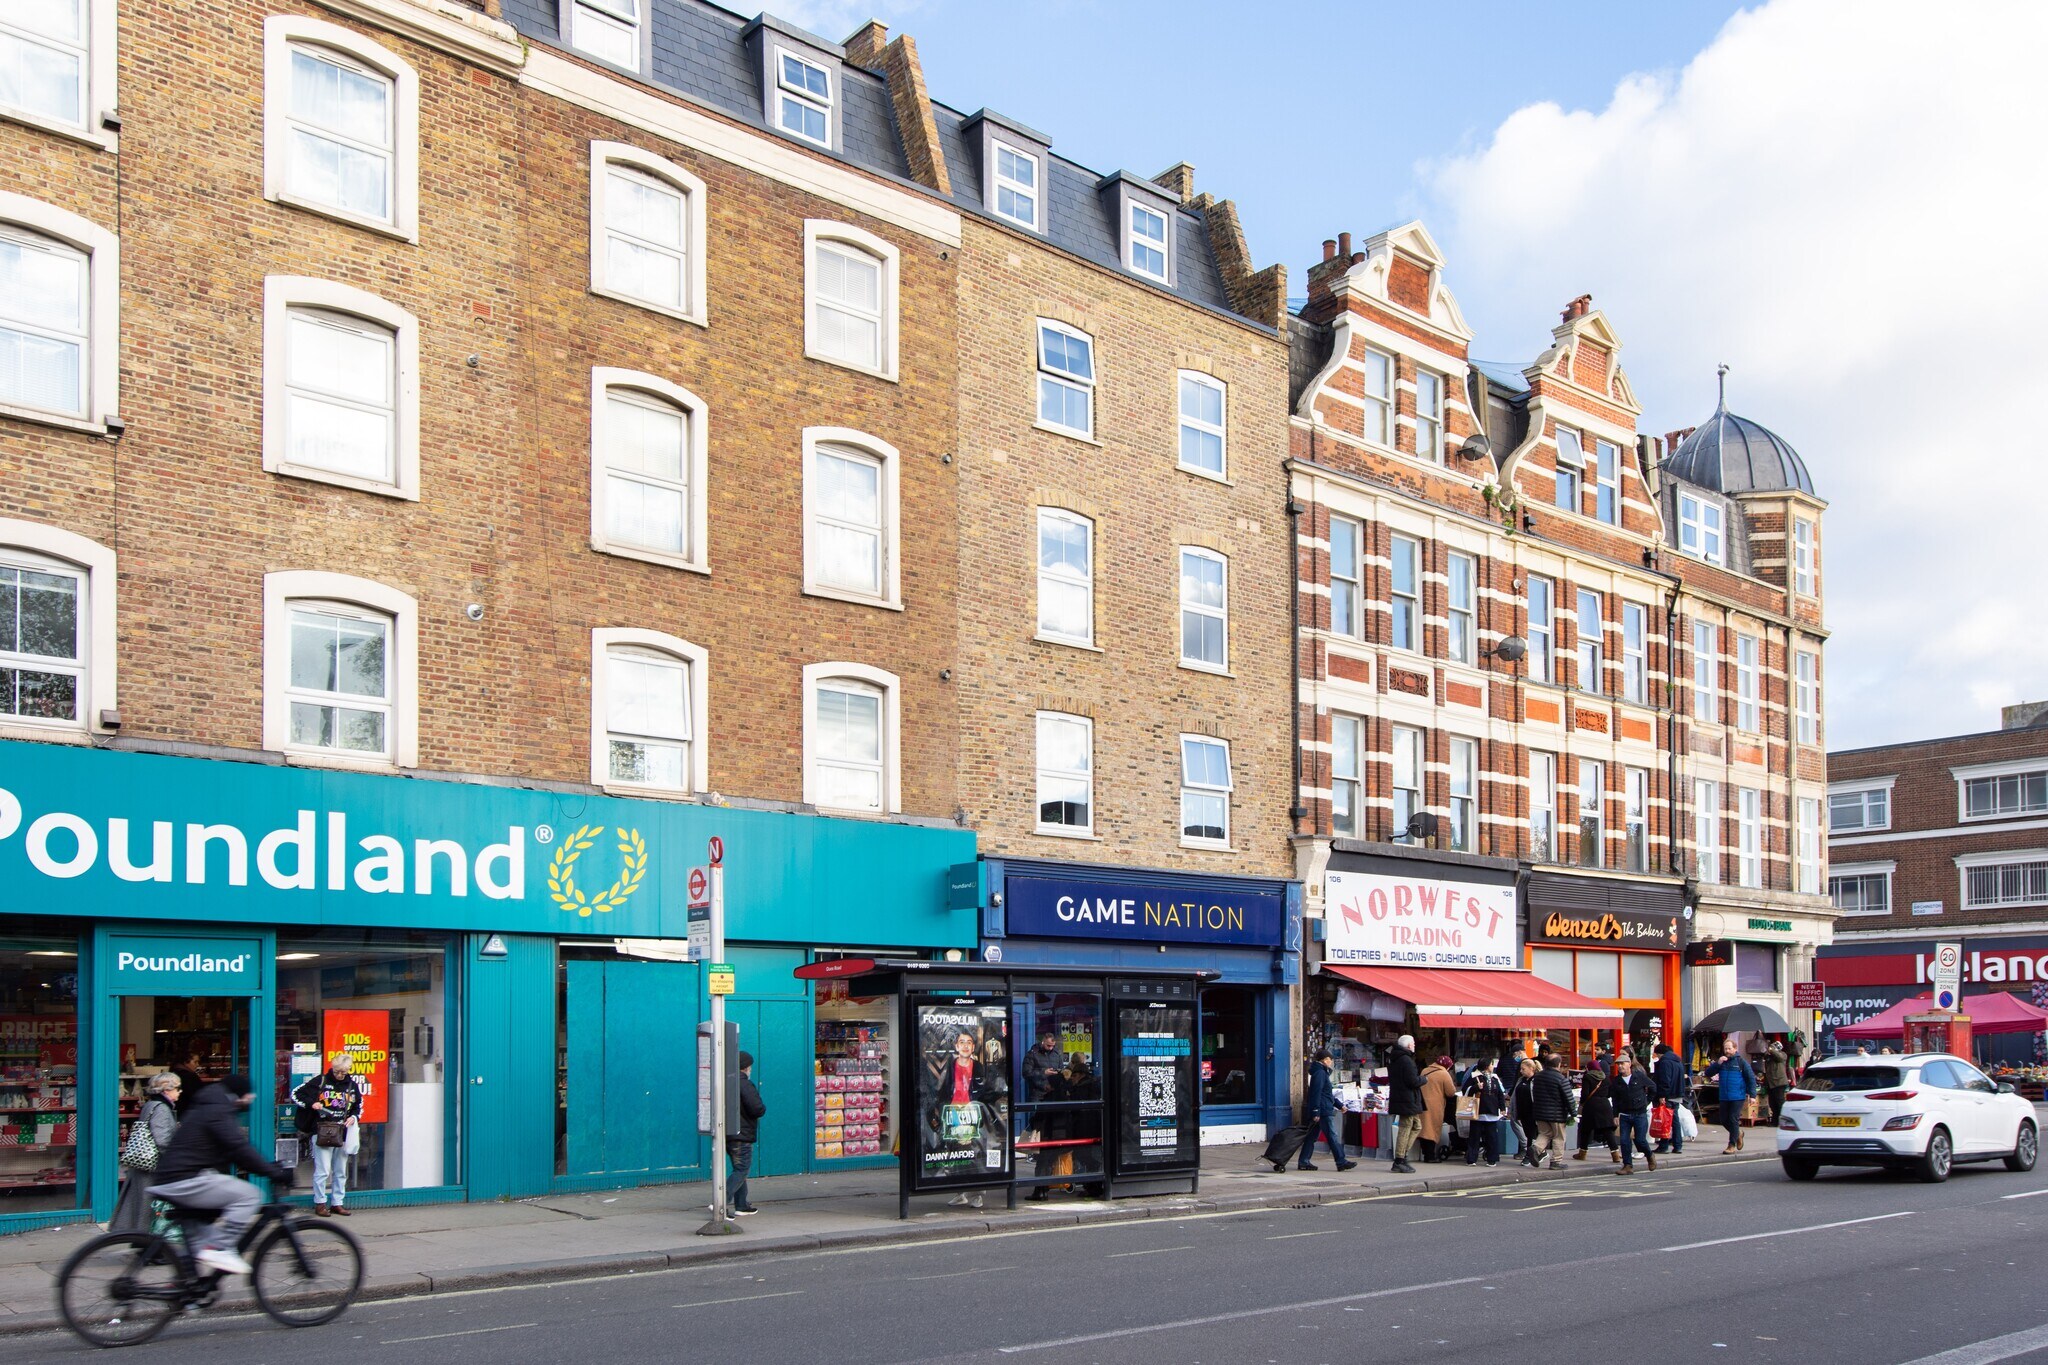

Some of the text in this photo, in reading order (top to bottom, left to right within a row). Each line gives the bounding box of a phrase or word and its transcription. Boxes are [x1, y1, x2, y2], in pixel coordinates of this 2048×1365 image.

[710, 840, 719, 860] N
[1056, 896, 1243, 930] GAME NATION
[1340, 886, 1503, 939] NORWEST
[1546, 912, 1664, 940] Wenzel's The Bakers
[1389, 926, 1462, 948] TRADING
[118, 952, 244, 972] Poundland
[1331, 949, 1381, 960] TOILETRIES
[1390, 951, 1427, 962] PILLOWS
[1436, 953, 1477, 964] CUSHIONS
[1916, 952, 2048, 984] Ilan
[1824, 997, 1890, 1010] hop now.
[923, 1014, 977, 1025] FOOTASYLUM
[1821, 1013, 1850, 1025] We'll
[2, 1022, 67, 1039] PRICE
[343, 1034, 370, 1044] 100s
[348, 1063, 375, 1074] OWN
[350, 1075, 365, 1083] OR
[926, 1152, 948, 1161] DANNY
